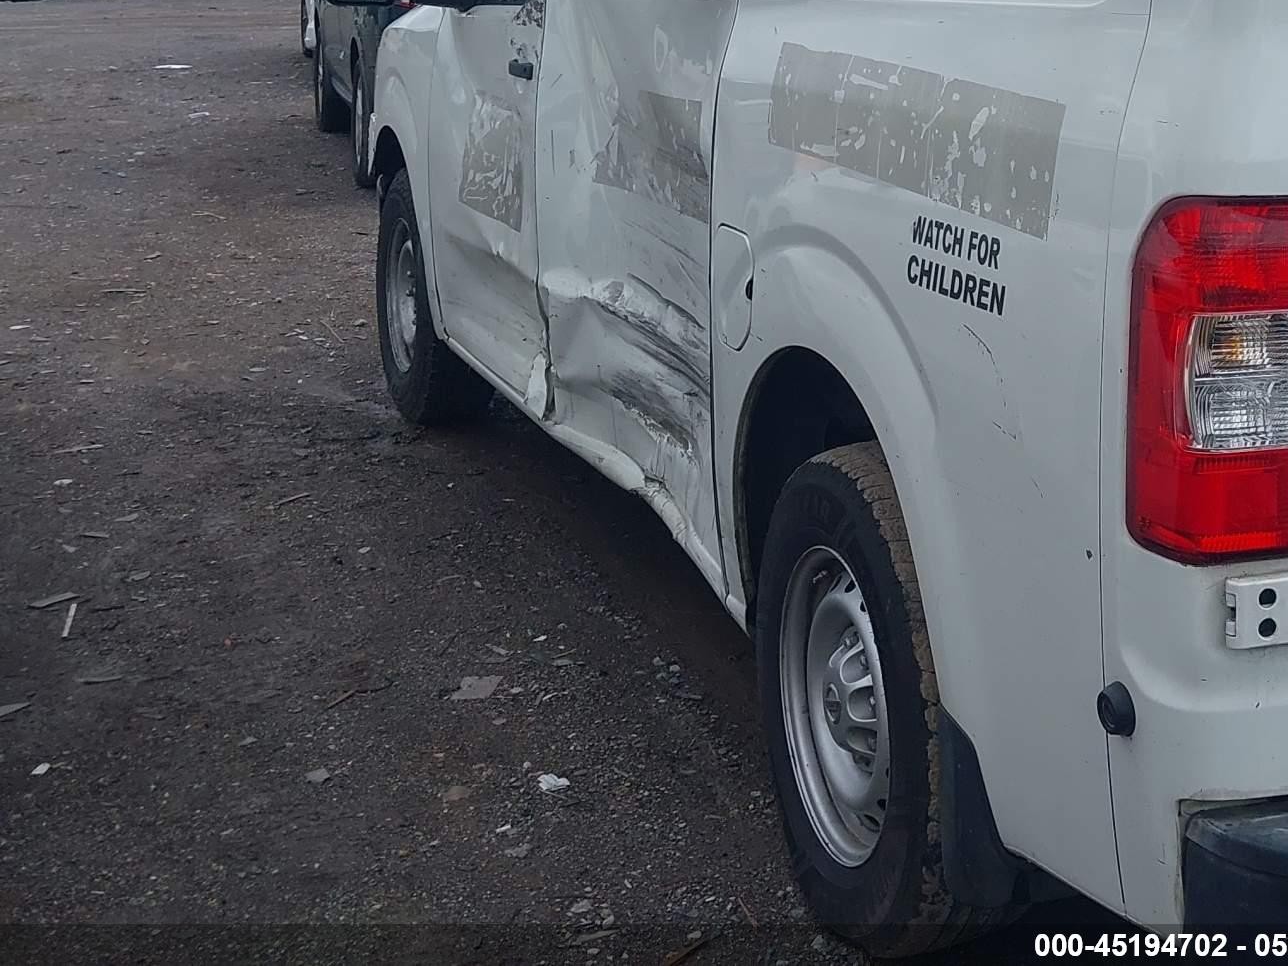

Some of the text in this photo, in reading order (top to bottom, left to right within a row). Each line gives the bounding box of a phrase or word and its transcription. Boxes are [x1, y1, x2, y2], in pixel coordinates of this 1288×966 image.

[912, 215, 1001, 270] WATCH FOR
[907, 254, 1006, 316] CHILDREN
